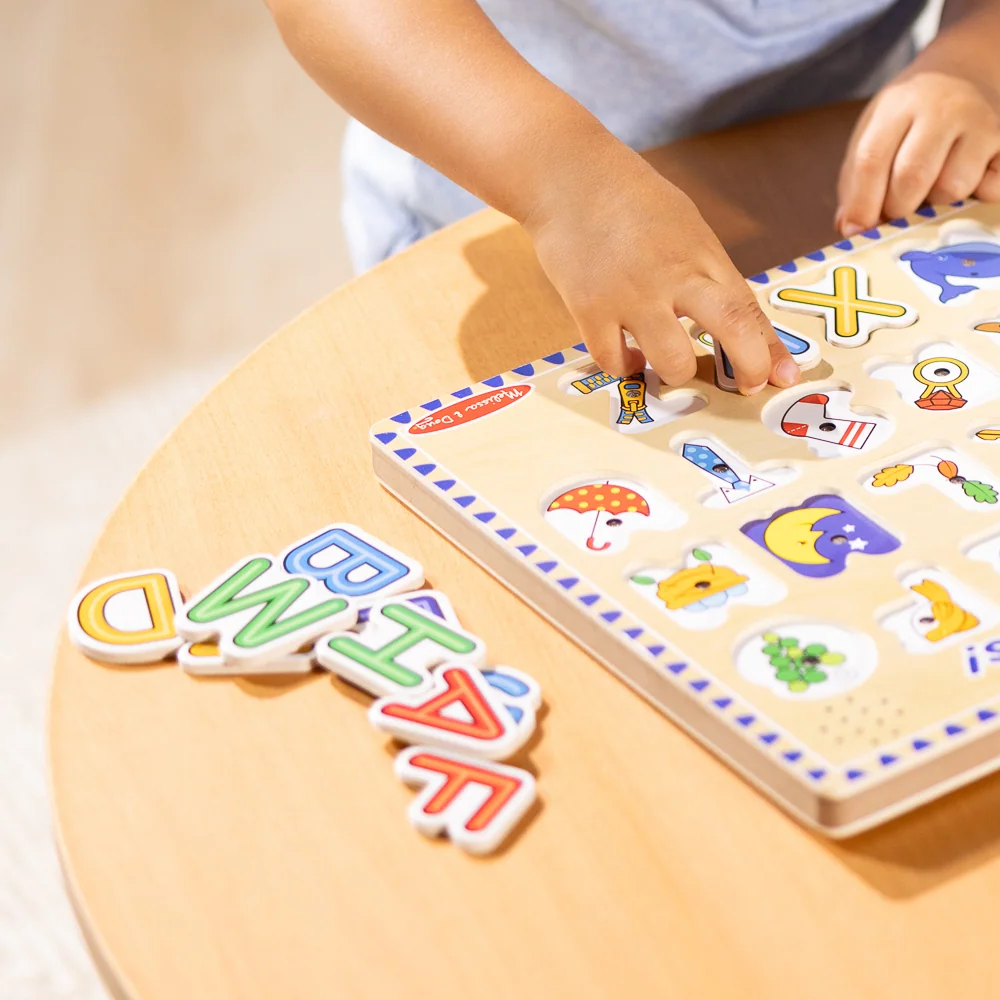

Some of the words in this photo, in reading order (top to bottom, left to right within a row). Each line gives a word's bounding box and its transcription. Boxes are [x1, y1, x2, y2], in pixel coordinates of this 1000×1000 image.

[777, 266, 906, 338] X
[416, 415, 454, 430] Doug
[465, 388, 523, 412] Melissa
[283, 527, 410, 597] B
[77, 572, 177, 645] D
[328, 603, 477, 688] H
[381, 667, 505, 741] A
[409, 753, 522, 831] F
